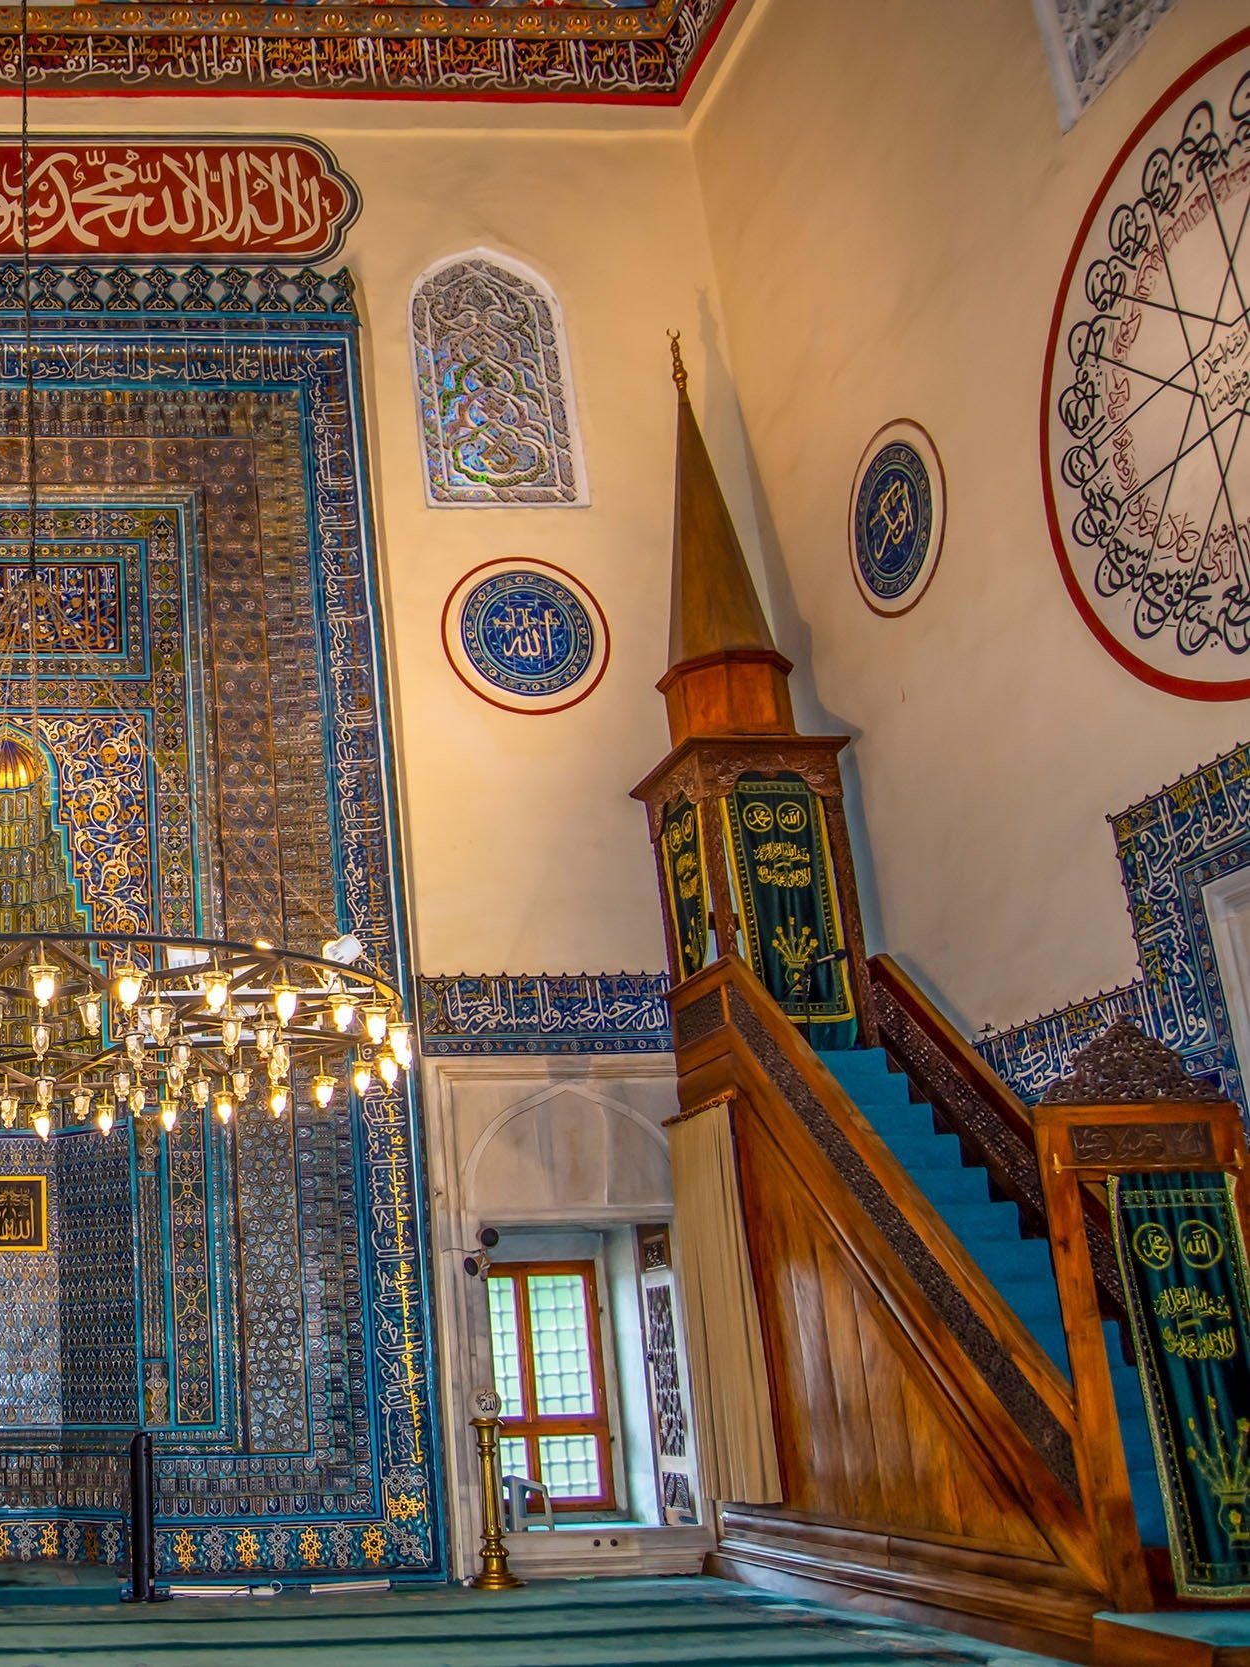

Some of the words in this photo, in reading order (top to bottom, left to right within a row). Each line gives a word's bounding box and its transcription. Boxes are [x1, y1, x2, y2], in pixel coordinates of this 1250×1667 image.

[502, 609, 553, 661] الله
[747, 806, 772, 828] محمد
[780, 806, 801, 828] الله
[1142, 1229, 1170, 1262] محمد
[1185, 1228, 1213, 1261] الله
